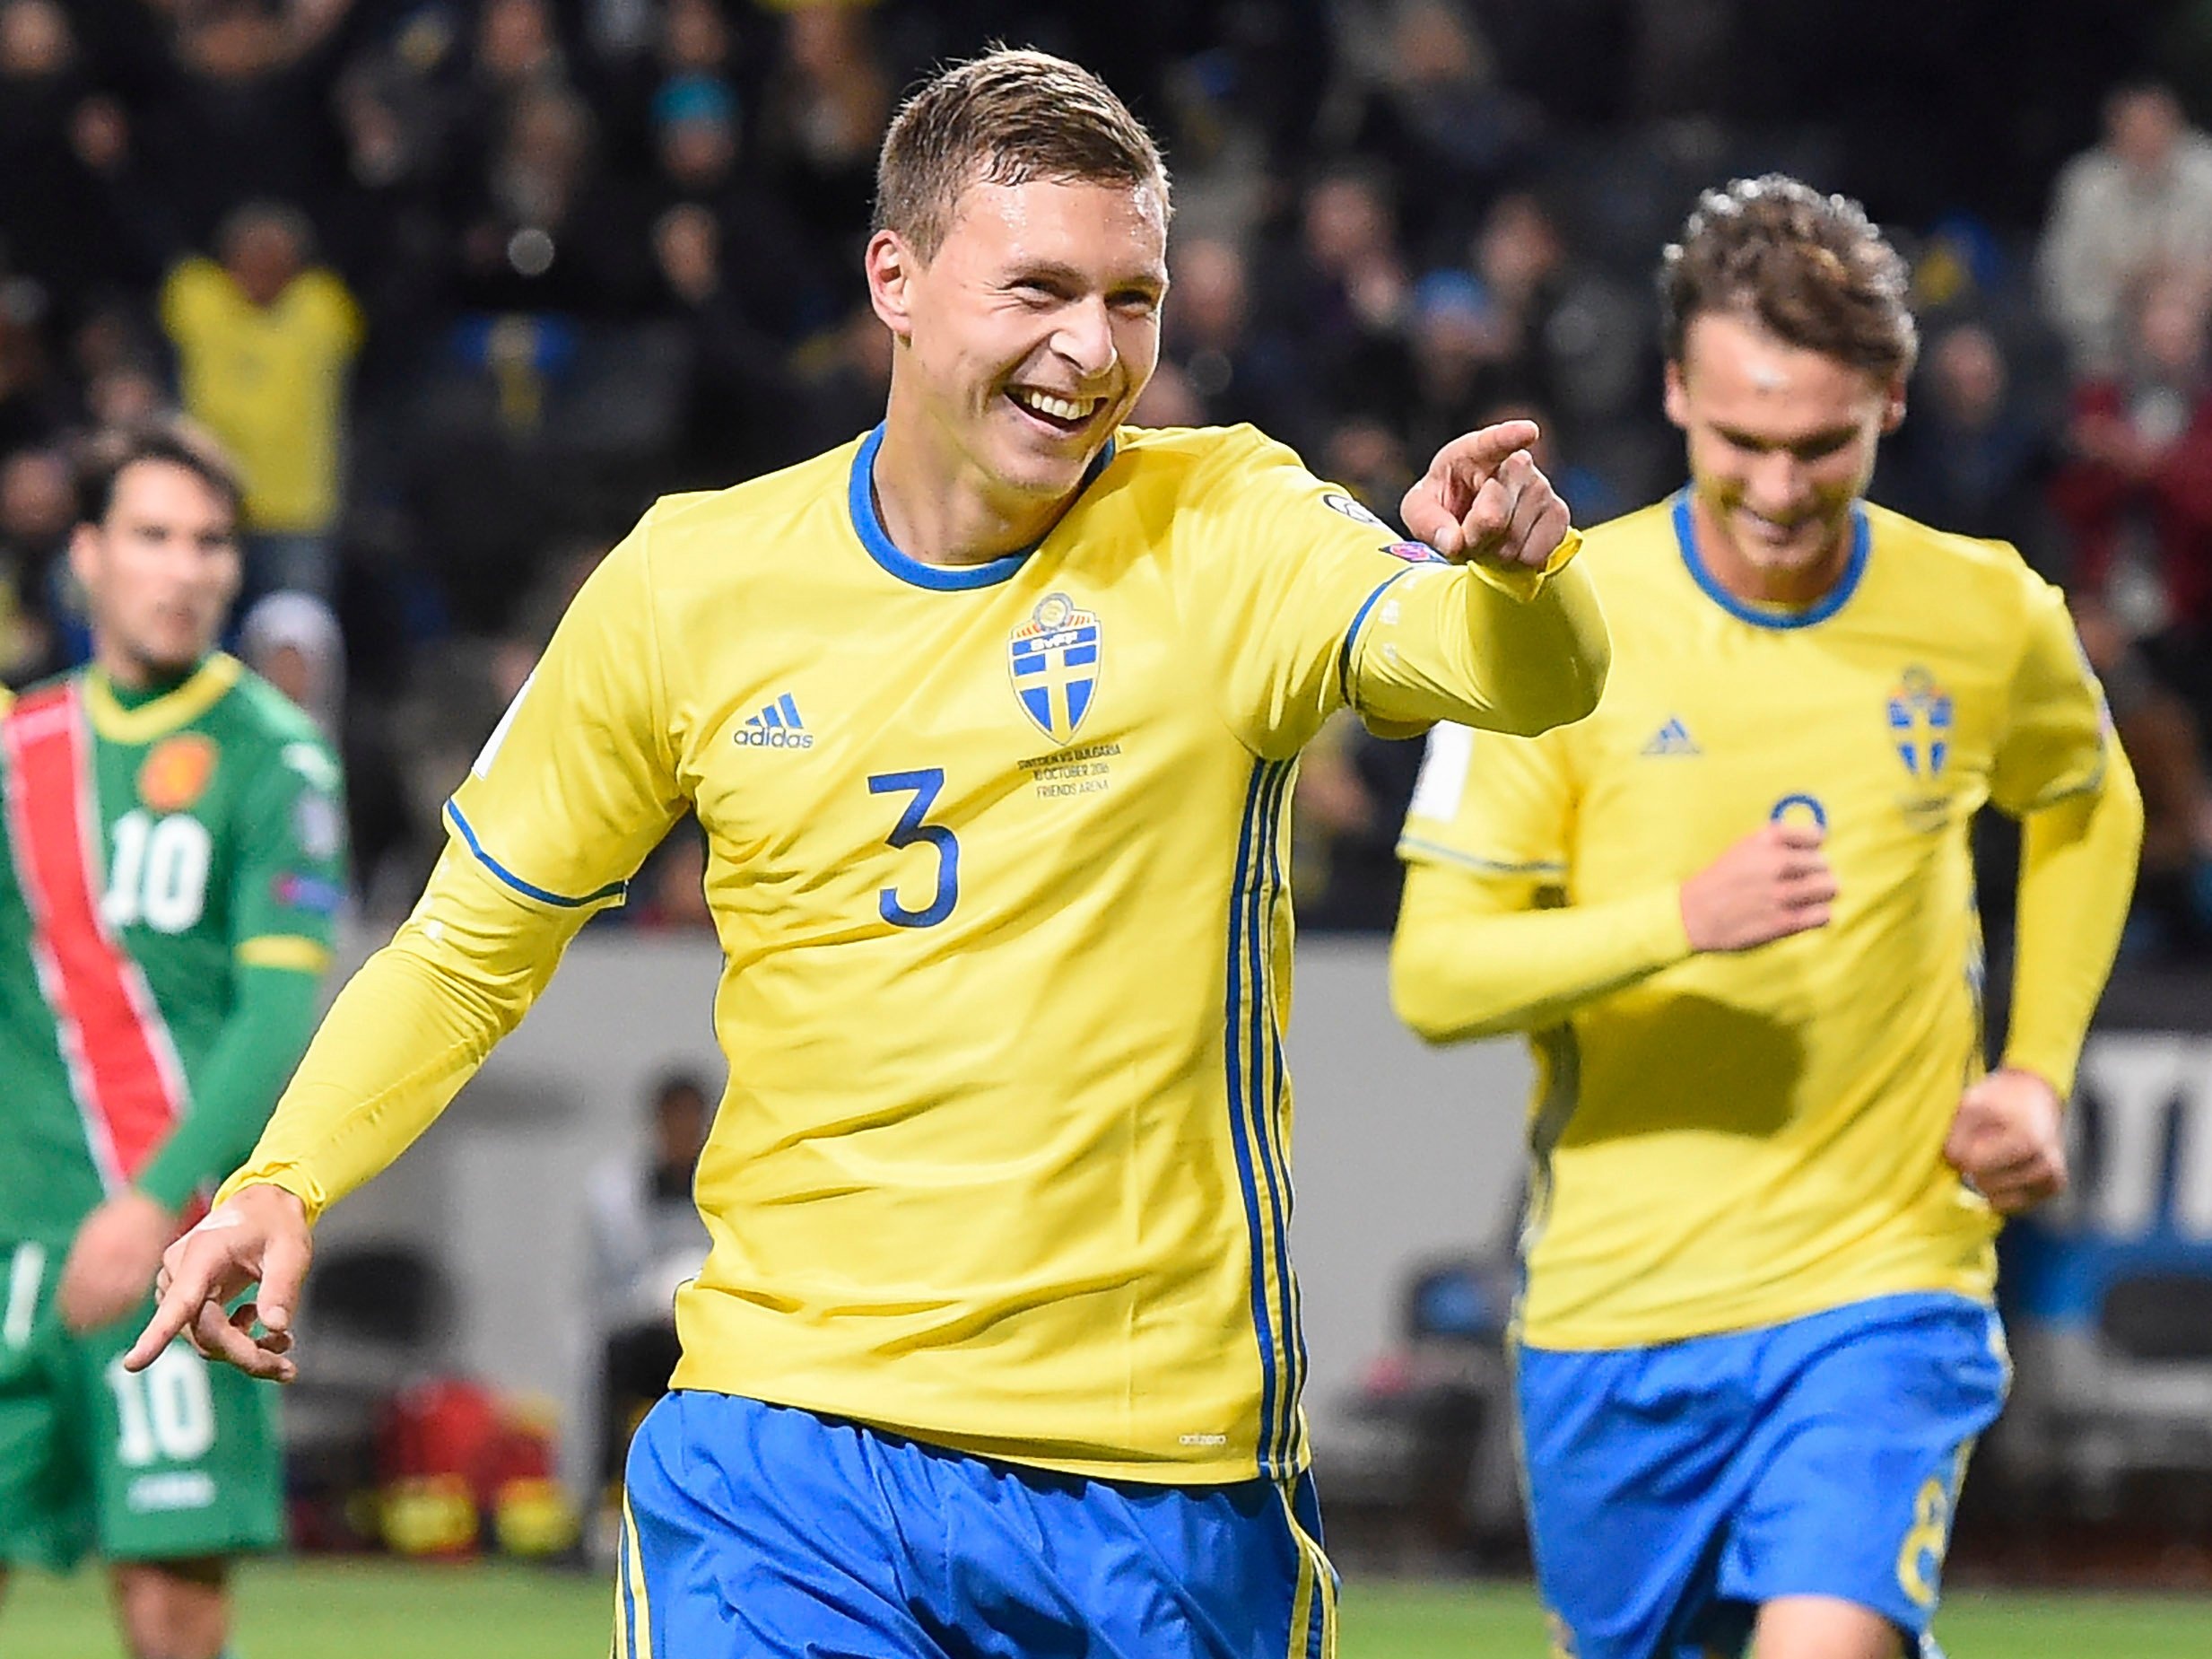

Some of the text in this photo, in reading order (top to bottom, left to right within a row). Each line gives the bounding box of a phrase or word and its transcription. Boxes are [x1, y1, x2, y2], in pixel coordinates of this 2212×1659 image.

[734, 727, 814, 749] adidas
[1017, 755, 1058, 770] SWEDEN
[1075, 744, 1120, 760] BULGARIA
[1044, 764, 1088, 780] OCTOBER
[1037, 780, 1109, 798] FRIENDS ARENA
[100, 809, 212, 934] 10
[867, 767, 960, 929] 3
[105, 1346, 214, 1465] 10
[1897, 1478, 1946, 1604] 8
